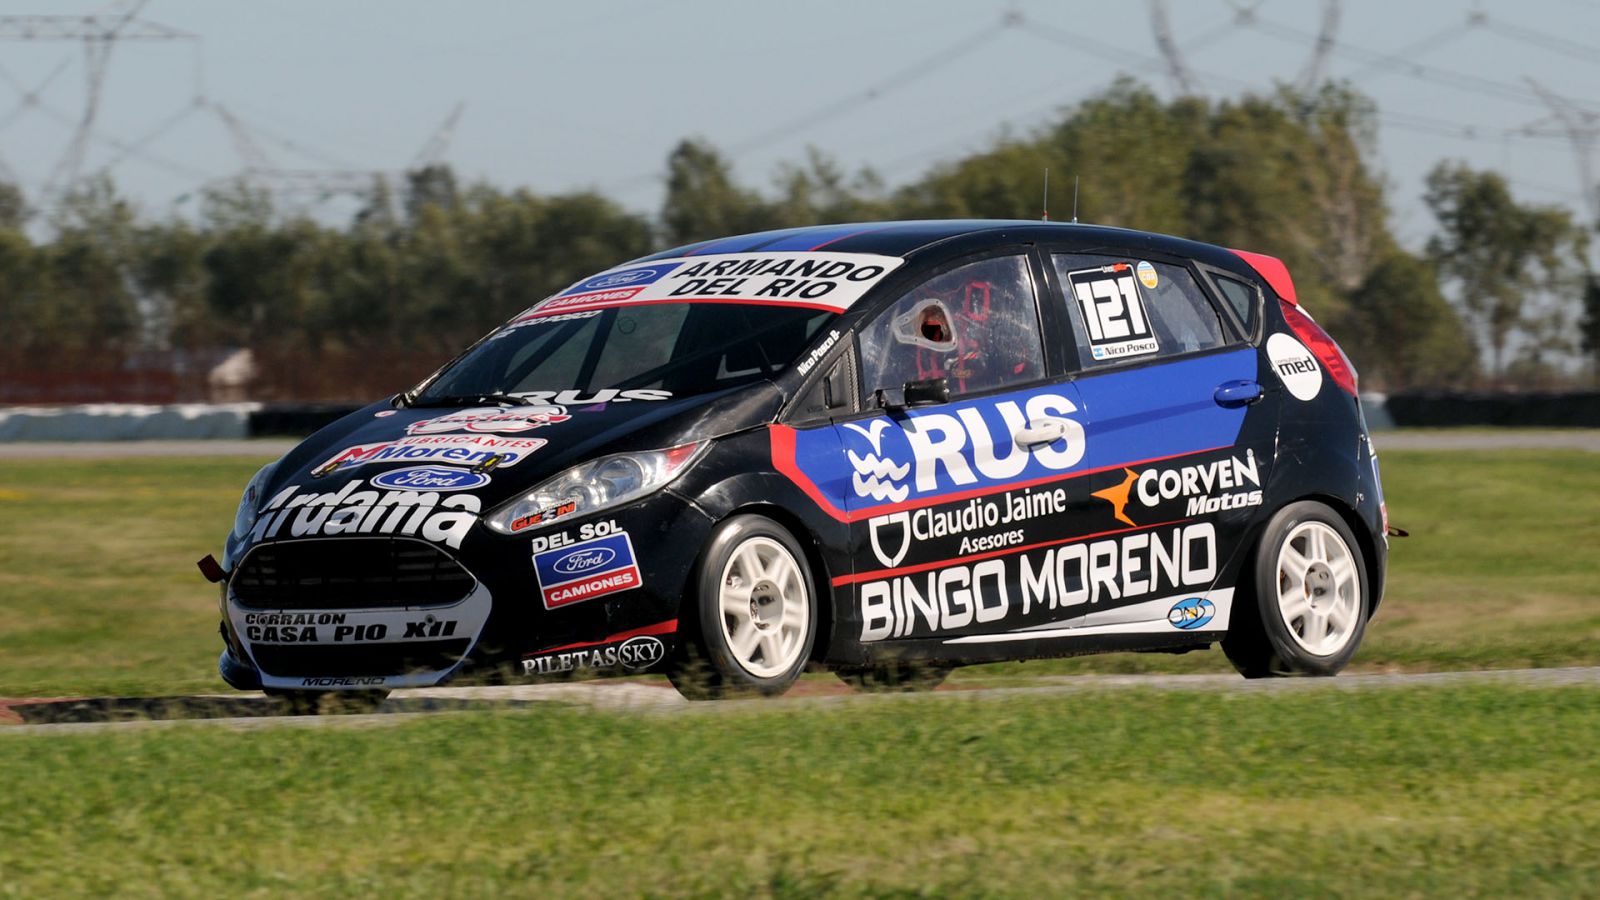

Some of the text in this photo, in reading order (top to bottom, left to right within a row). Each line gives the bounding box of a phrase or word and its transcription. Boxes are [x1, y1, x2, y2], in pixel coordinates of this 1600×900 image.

[672, 258, 884, 282] ARMANDO
[546, 290, 635, 309] CAMIONES
[668, 277, 838, 299] DEL RIO
[1074, 276, 1147, 341] 121
[797, 357, 815, 376] Nico
[811, 337, 835, 361] Posco
[1104, 342, 1156, 356] Nico Posco
[1278, 355, 1317, 377] med
[505, 388, 673, 407] RUS
[905, 394, 1086, 492] RUS
[394, 468, 461, 486] Ford
[1137, 449, 1261, 507] CORVEN
[911, 488, 1067, 541] Claudio Jaime
[1186, 489, 1262, 517] Motos
[532, 520, 622, 553] DEL SOL
[959, 527, 1025, 556] Asesores
[566, 552, 604, 571] Ford
[550, 573, 633, 601] CAMIONES
[860, 522, 1218, 643] BINGO MORENO
[245, 613, 346, 625] CORRALON
[246, 620, 458, 642] CASA PIO XII
[521, 642, 658, 676] PILETAS SKY
[301, 676, 386, 686] MORENO
